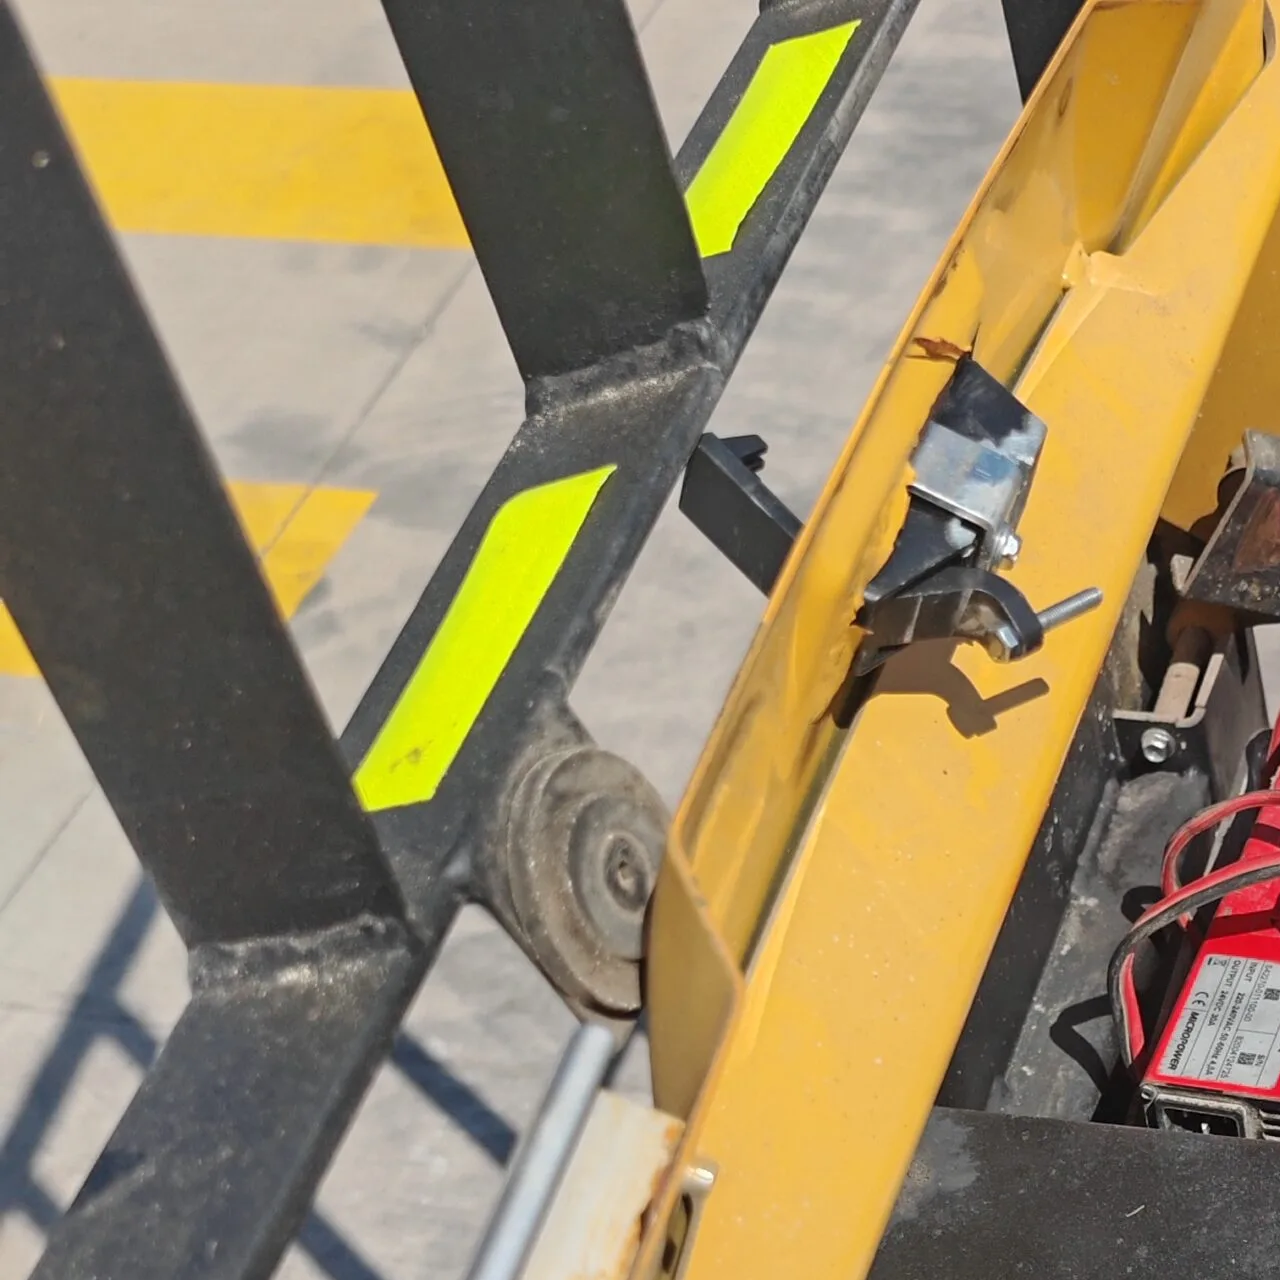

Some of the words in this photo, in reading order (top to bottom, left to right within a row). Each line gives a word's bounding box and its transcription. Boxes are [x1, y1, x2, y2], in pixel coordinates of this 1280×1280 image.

[1224, 960, 1242, 988] OUTPUT
[1244, 962, 1258, 983] INPUT
[1213, 990, 1229, 1012] 24VDC
[1168, 1011, 1199, 1071] MICROPOWER
